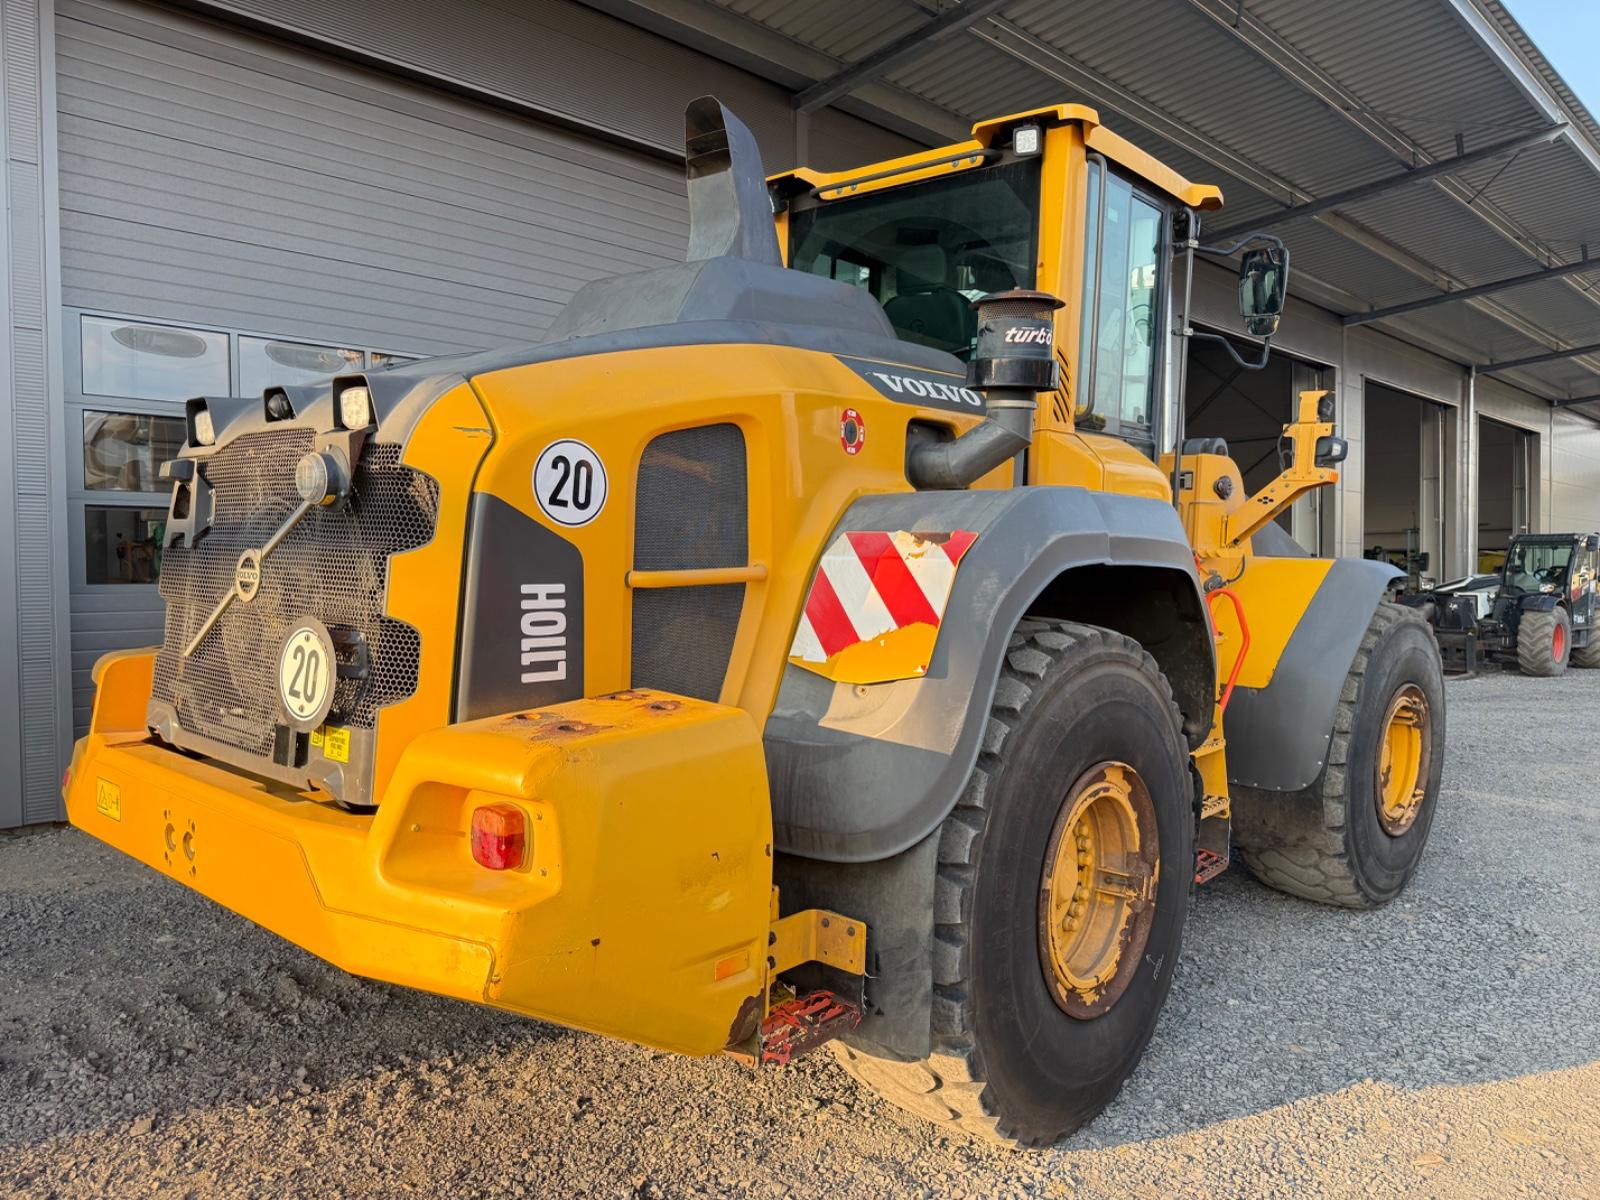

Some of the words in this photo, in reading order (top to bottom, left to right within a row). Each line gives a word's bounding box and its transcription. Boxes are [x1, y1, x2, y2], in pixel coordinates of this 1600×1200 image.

[1004, 326, 1053, 345] turbo
[873, 372, 982, 406] VOLVO
[548, 455, 593, 511] 20
[520, 583, 567, 684] L110H
[288, 644, 320, 704] 20
